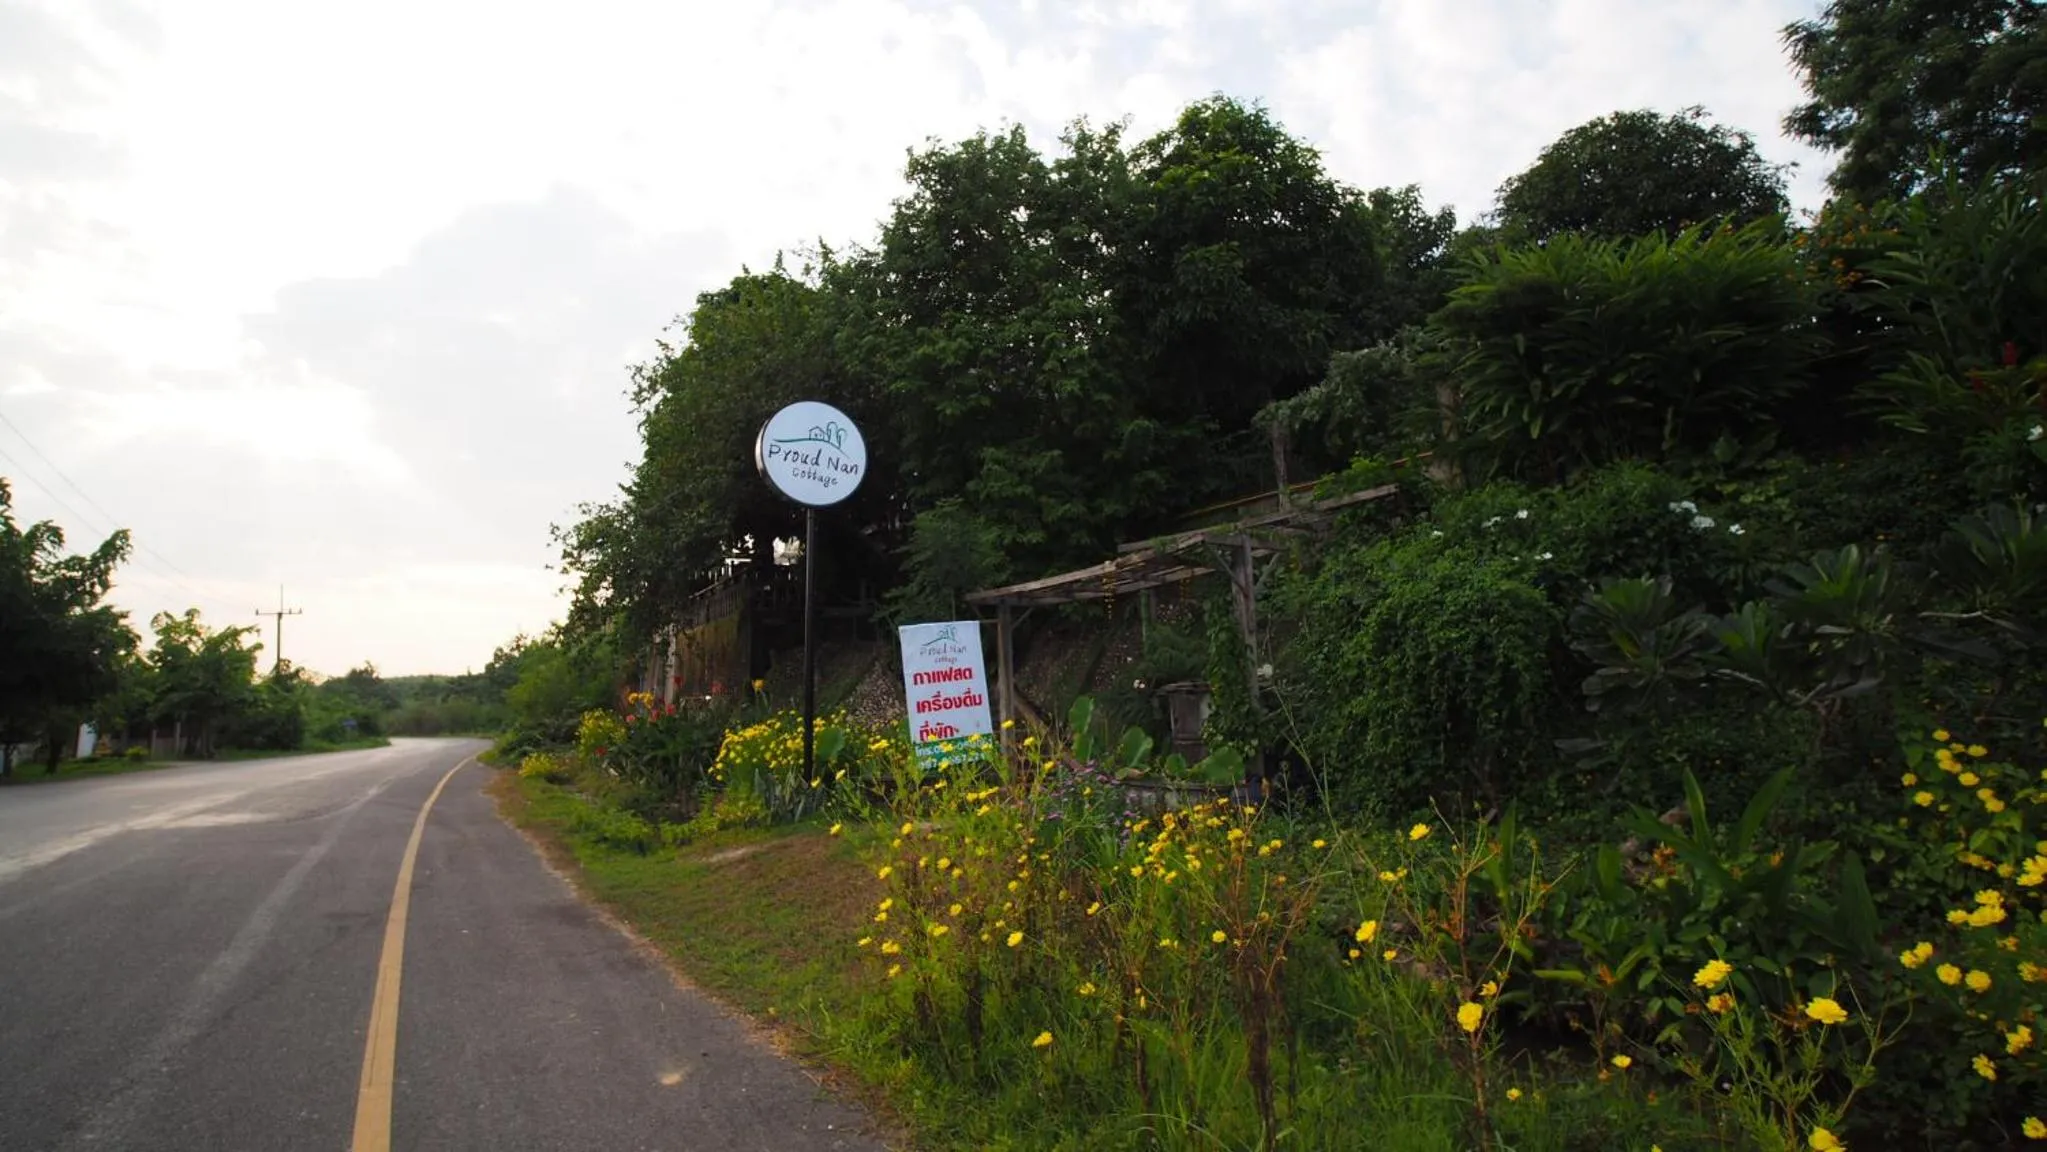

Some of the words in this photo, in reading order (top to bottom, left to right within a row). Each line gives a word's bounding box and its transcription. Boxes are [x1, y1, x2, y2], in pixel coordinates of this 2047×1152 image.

[768, 444, 822, 466] Proud
[827, 457, 859, 475] Nan
[913, 667, 973, 685] กาแฟสด
[916, 688, 983, 713] เครื่องดื่ม
